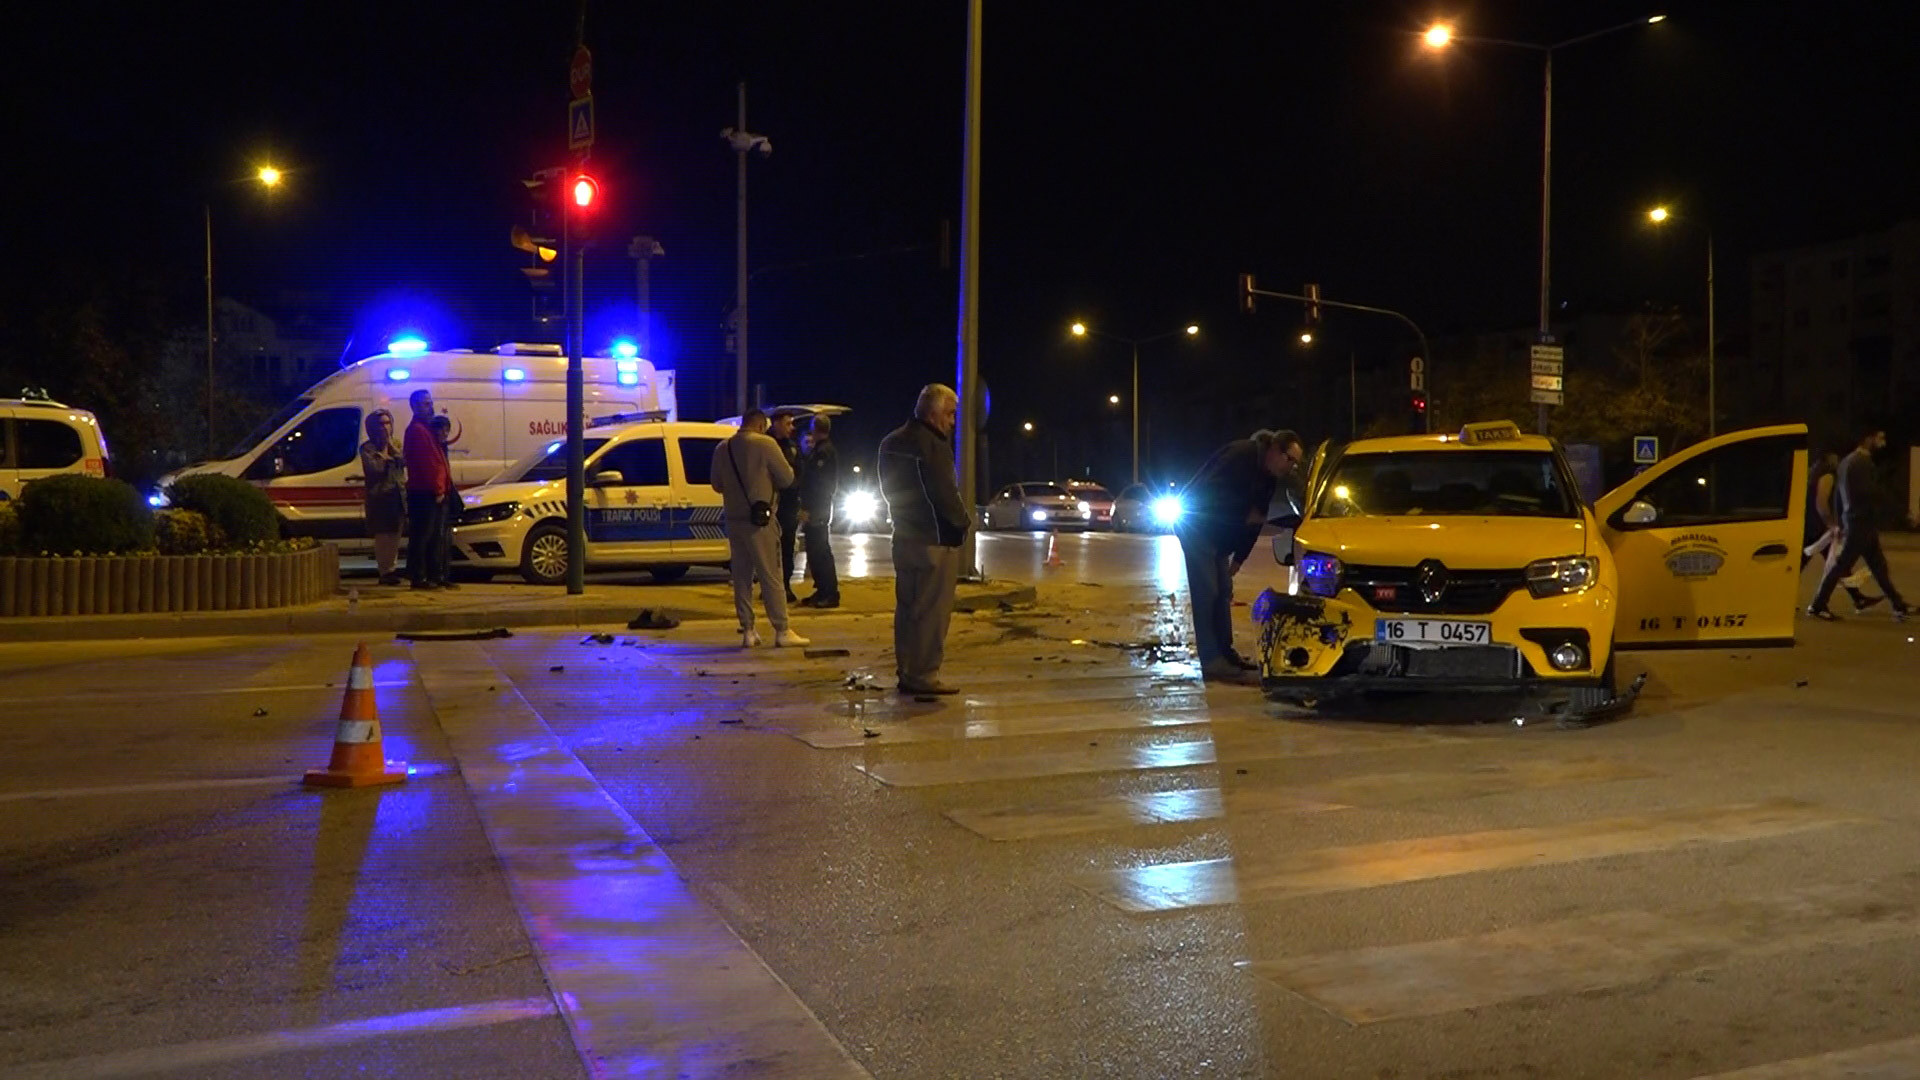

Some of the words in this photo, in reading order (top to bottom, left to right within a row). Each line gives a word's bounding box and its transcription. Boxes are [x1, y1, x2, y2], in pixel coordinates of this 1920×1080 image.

[1640, 617, 1660, 630] 16
[1672, 616, 1687, 629] T
[1697, 614, 1748, 628] 0457
[1387, 622, 1404, 638] 16
[1418, 622, 1429, 638] T
[1441, 623, 1487, 642] 0457
